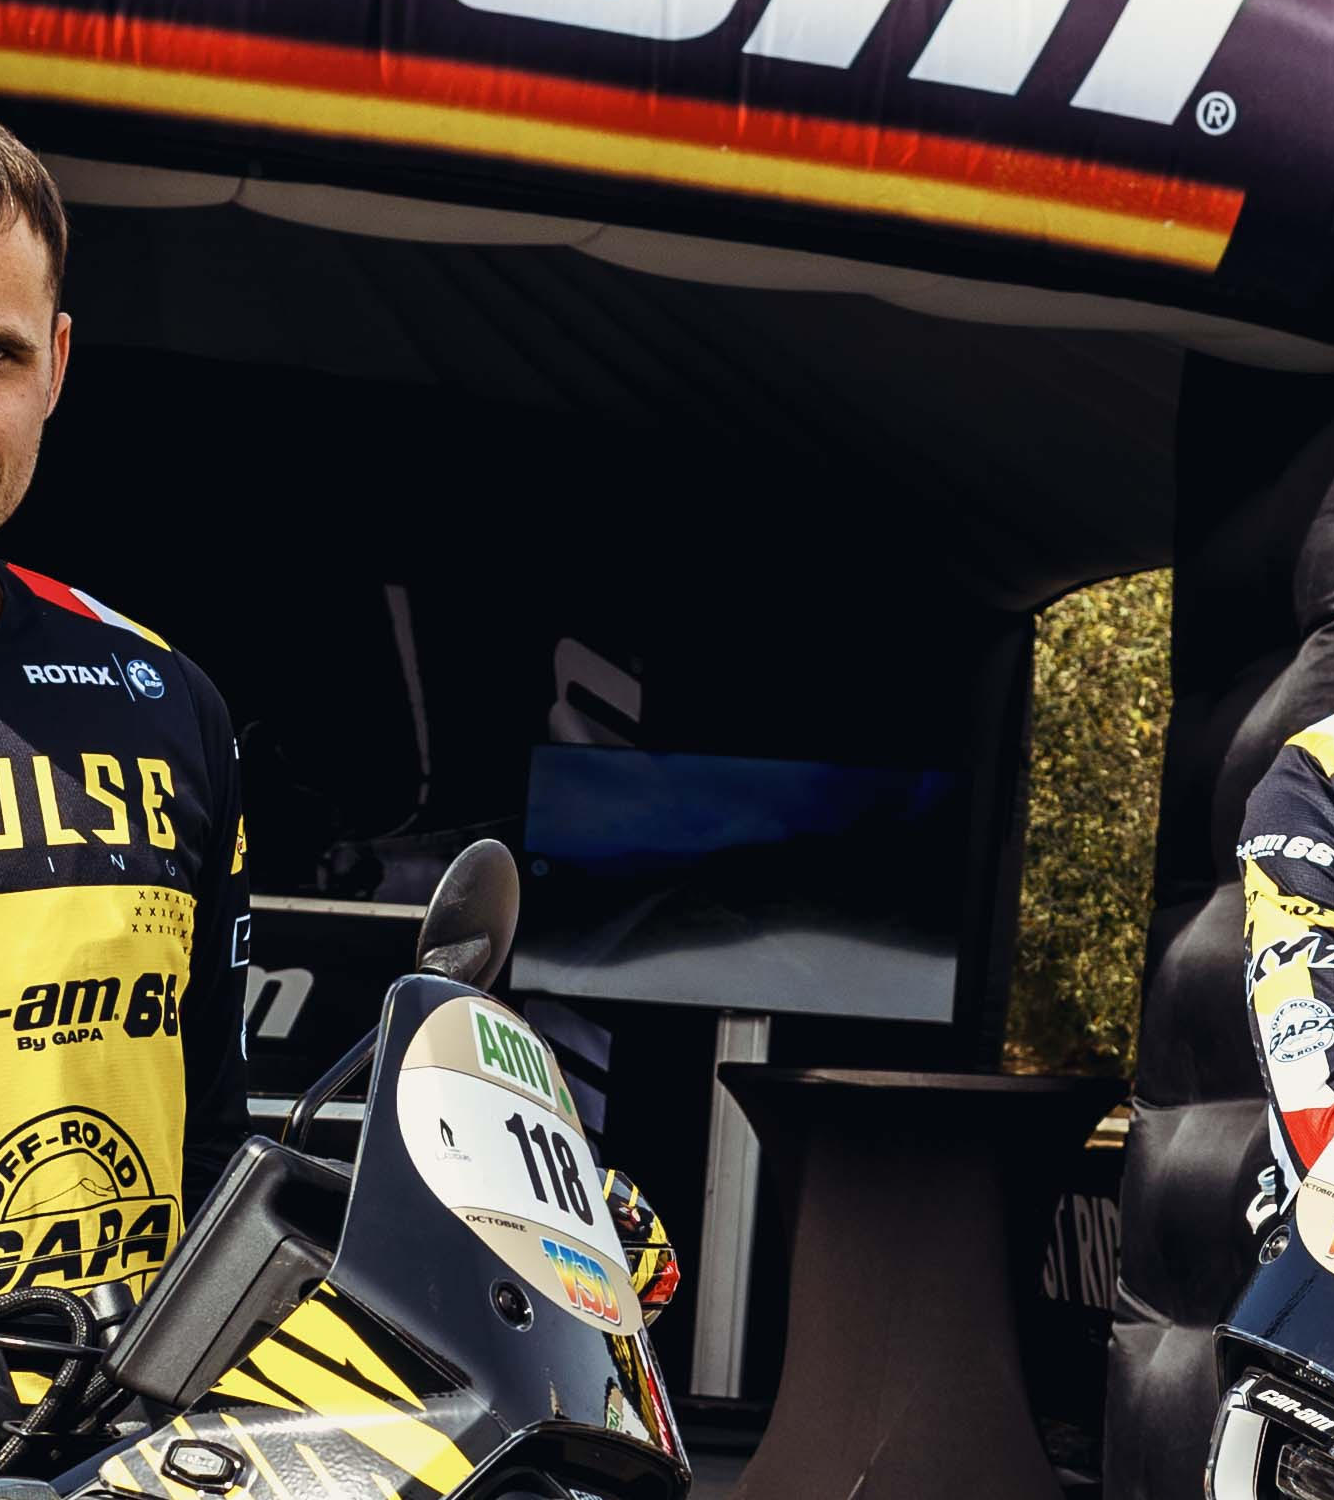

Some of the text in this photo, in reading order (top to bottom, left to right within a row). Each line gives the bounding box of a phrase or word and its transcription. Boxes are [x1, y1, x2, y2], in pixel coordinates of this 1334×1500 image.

[23, 662, 119, 688] ROTAX
[16, 1027, 104, 1052] By GAPA
[475, 1011, 553, 1099] AMV
[505, 1111, 594, 1227] 118
[465, 1213, 528, 1233] OCTOBRE
[539, 1235, 622, 1326] VSD
